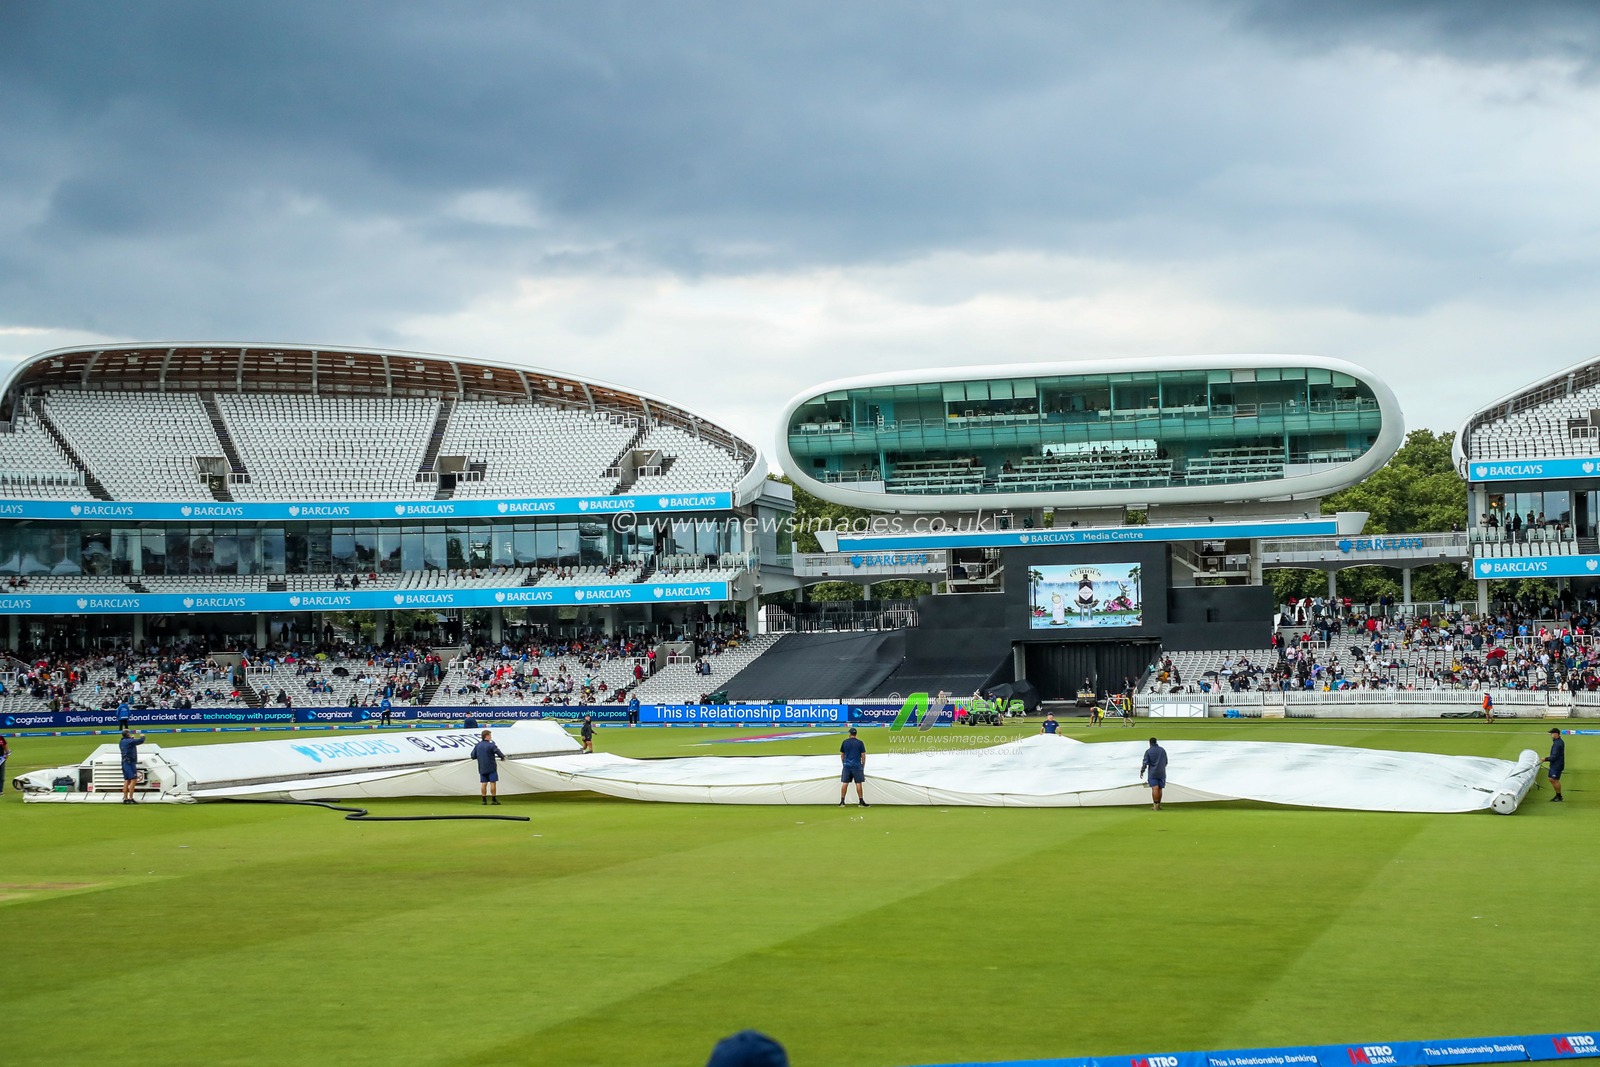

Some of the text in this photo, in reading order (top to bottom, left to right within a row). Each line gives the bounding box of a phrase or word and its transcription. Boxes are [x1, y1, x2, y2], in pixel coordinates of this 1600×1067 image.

[1489, 465, 1543, 476] BARCLAYS
[509, 502, 555, 512] BARCLAYS
[591, 499, 635, 510] BARCLAYS
[670, 496, 716, 507] BARCLAYS
[84, 506, 133, 516] BARCLAYS
[194, 507, 243, 517] BARCLAYS
[301, 506, 350, 516] BARCLAYS
[407, 504, 454, 514] BARCLAYS
[1031, 531, 1144, 543] BARCLAYS Media Centre
[1356, 537, 1423, 550] BARCLAYS
[866, 553, 928, 566] BARCLAYS
[1494, 561, 1548, 573] BARCLAYS
[507, 591, 553, 602] BARCLAYS
[586, 589, 632, 600] BARCLAYS
[665, 586, 711, 597] BARCLAYS
[89, 598, 140, 609] BARCLAYS
[196, 597, 246, 608] BARCLAYS
[302, 596, 351, 606] BARCLAYS
[406, 594, 454, 604] BARCLAYS
[65, 714, 103, 724] Delivering
[151, 713, 177, 721] cricket
[203, 713, 245, 721] technology
[246, 712, 263, 720] with
[317, 710, 353, 720] cognizant
[417, 710, 451, 719] Delivering
[494, 710, 518, 718] cricket
[519, 710, 529, 718] for
[541, 710, 580, 719] technology
[597, 710, 627, 719] purpose
[654, 705, 838, 722] This is Relationship Banking
[16, 715, 54, 726] cognizant
[311, 739, 400, 759] BARCLAYS
[1423, 1043, 1526, 1056] This is Relationship Banking
[1552, 1035, 1595, 1054] METRO
[1574, 1045, 1600, 1054] BANK
[1209, 1058, 1228, 1067] This
[1236, 1055, 1285, 1066] Relationship
[1284, 1054, 1318, 1064] Banking
[1347, 1045, 1393, 1065] METRO
[1369, 1056, 1397, 1065] BANK
